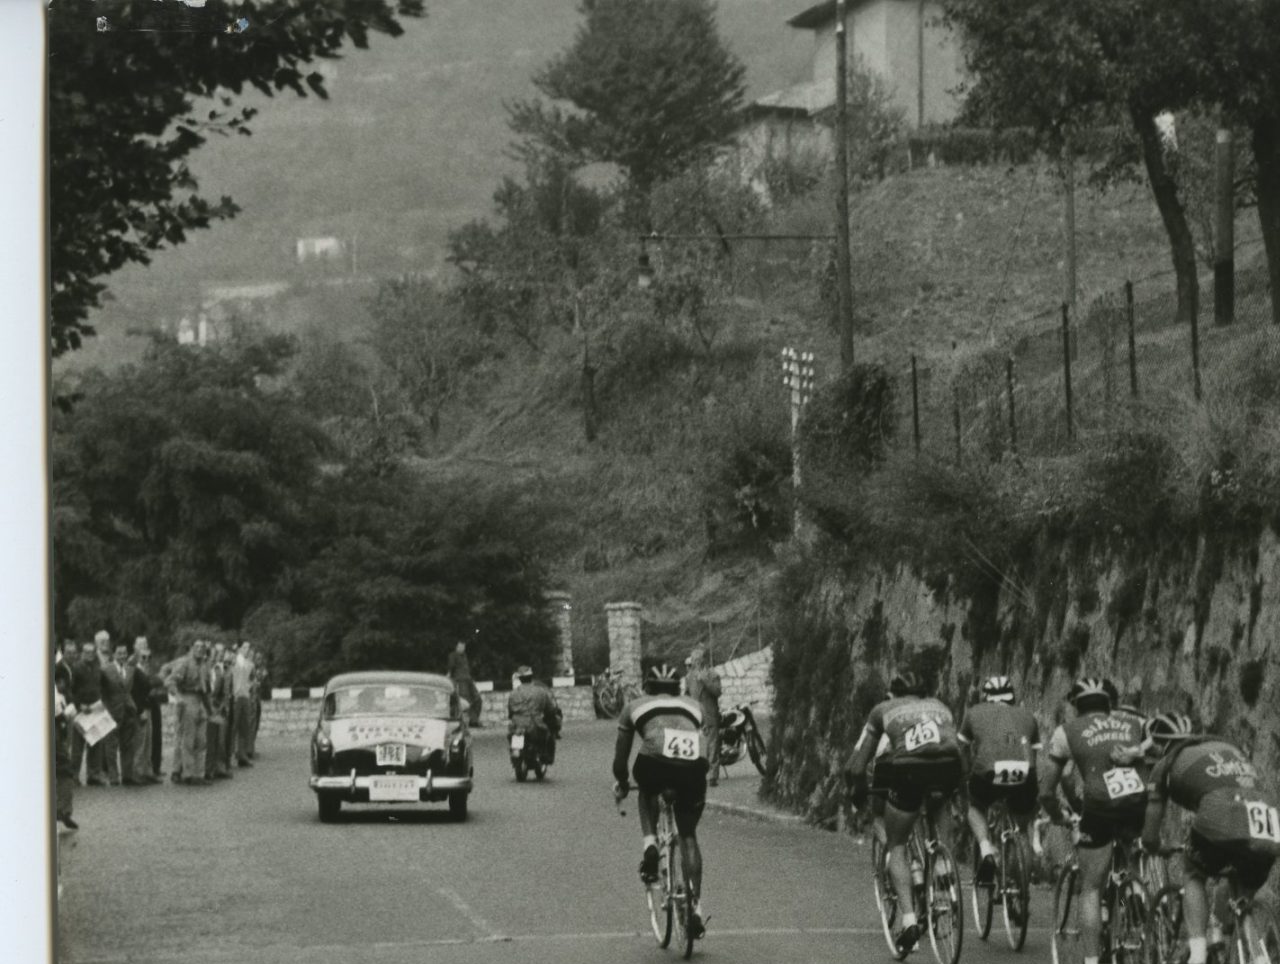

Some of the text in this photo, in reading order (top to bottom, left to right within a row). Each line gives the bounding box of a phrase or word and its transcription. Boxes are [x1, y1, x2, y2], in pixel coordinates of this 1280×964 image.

[910, 721, 936, 746] 45
[667, 736, 695, 758] 43
[1105, 768, 1141, 796] 55
[1250, 806, 1276, 838] 61
